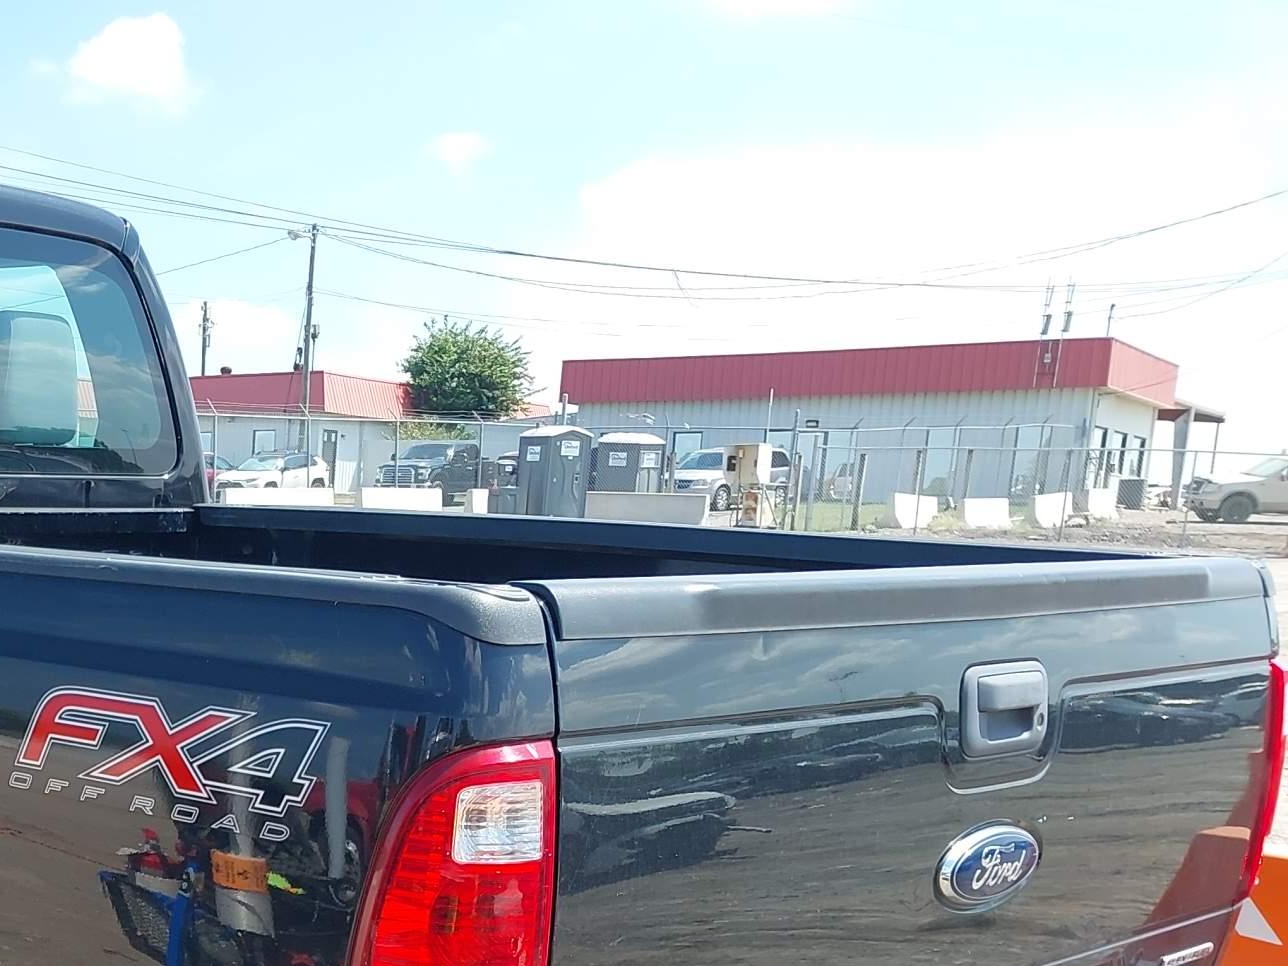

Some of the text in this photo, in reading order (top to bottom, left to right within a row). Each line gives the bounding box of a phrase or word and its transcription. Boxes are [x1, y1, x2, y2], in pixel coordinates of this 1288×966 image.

[15, 686, 331, 817] FX4
[9, 771, 290, 841] OFF ROAD
[972, 843, 1026, 890] Ford
